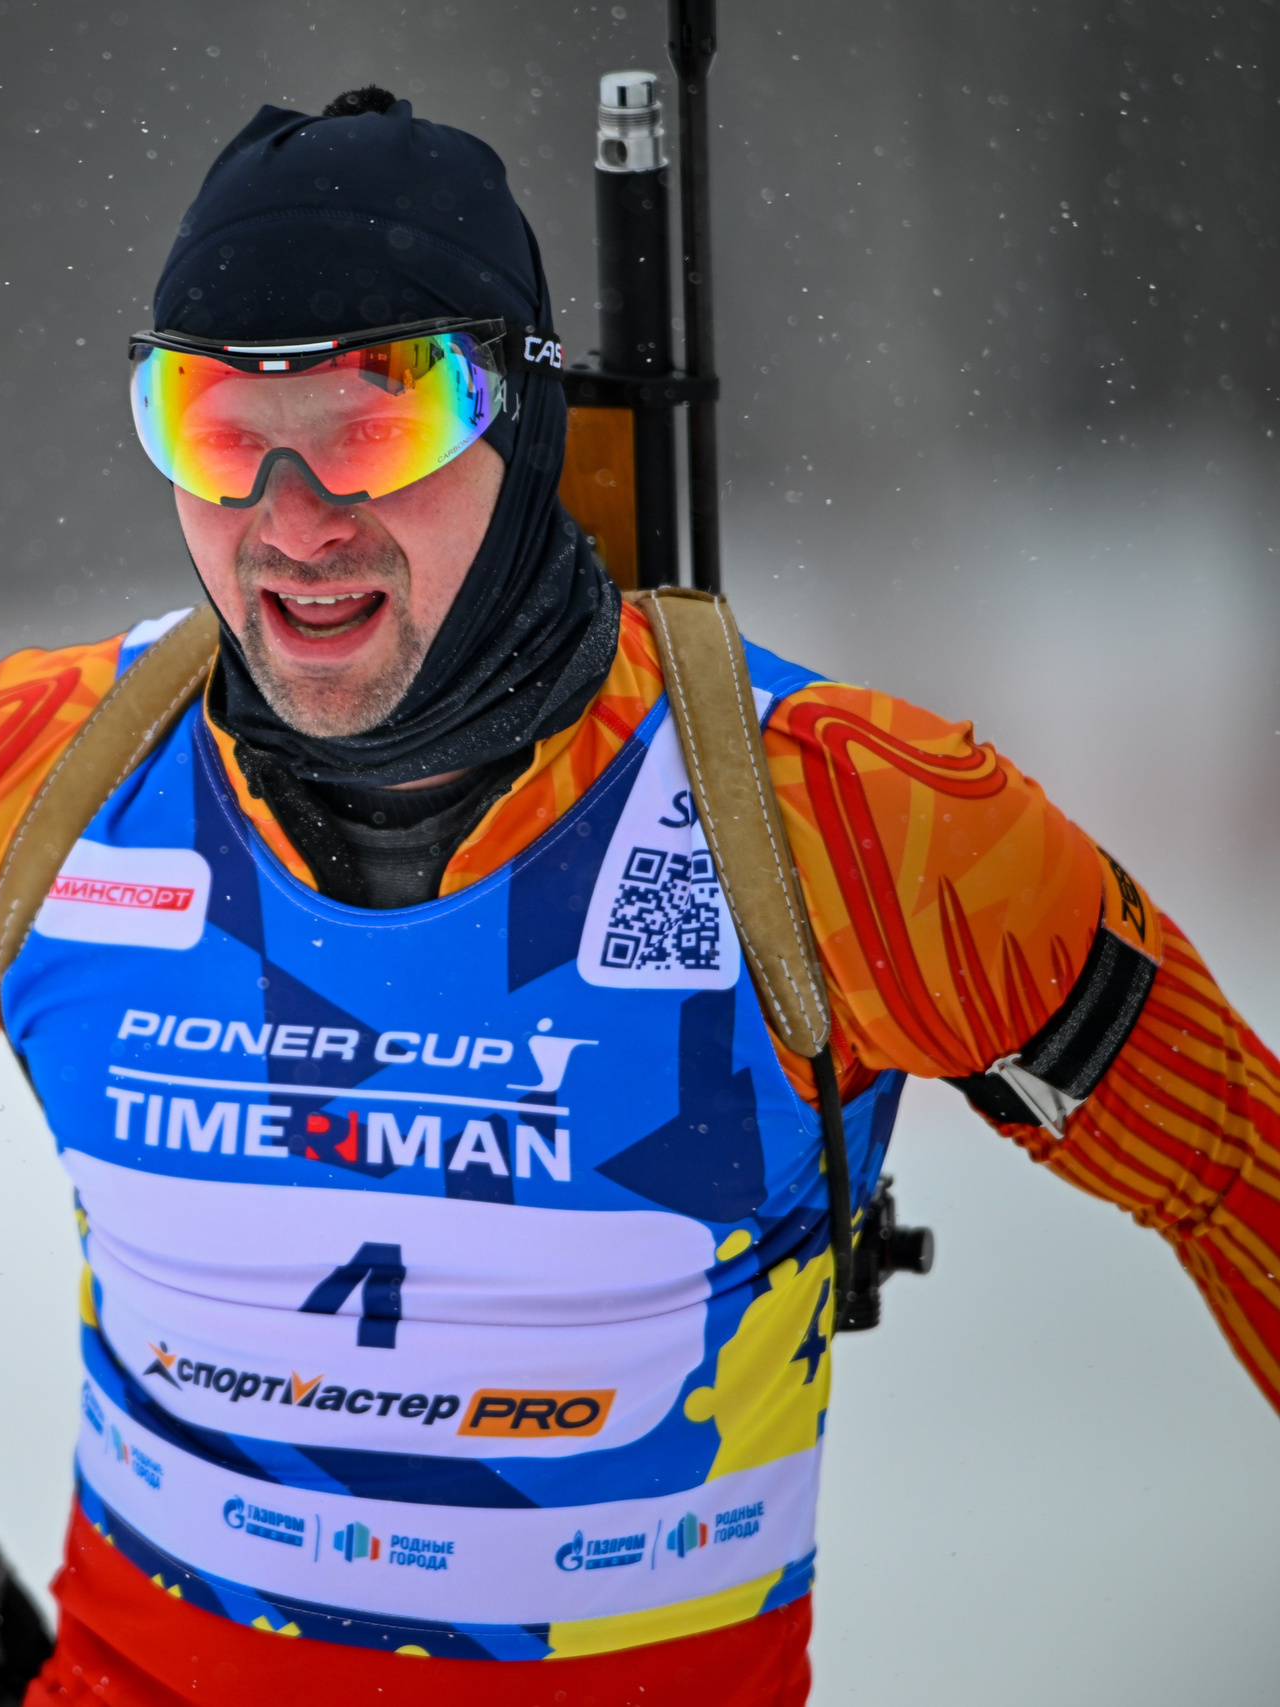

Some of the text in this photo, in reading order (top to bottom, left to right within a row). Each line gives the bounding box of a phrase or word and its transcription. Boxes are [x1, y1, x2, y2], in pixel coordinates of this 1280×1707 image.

[524, 336, 564, 369] CAS
[658, 790, 698, 829] S
[50, 879, 191, 908] МИНСПОРТ
[118, 1009, 513, 1069] PIONER CUP
[105, 1086, 572, 1182] TIMERMAN
[469, 1396, 601, 1430] PRO
[247, 1504, 305, 1533] ГАЗПРОМ
[715, 1501, 764, 1528] РОДНЫЕ
[390, 1534, 455, 1555] РОДНЫЕ
[586, 1533, 646, 1556] ГАЗПРОМ
[714, 1519, 759, 1544] ГОРОДА
[389, 1550, 448, 1571] ГОРОДА
